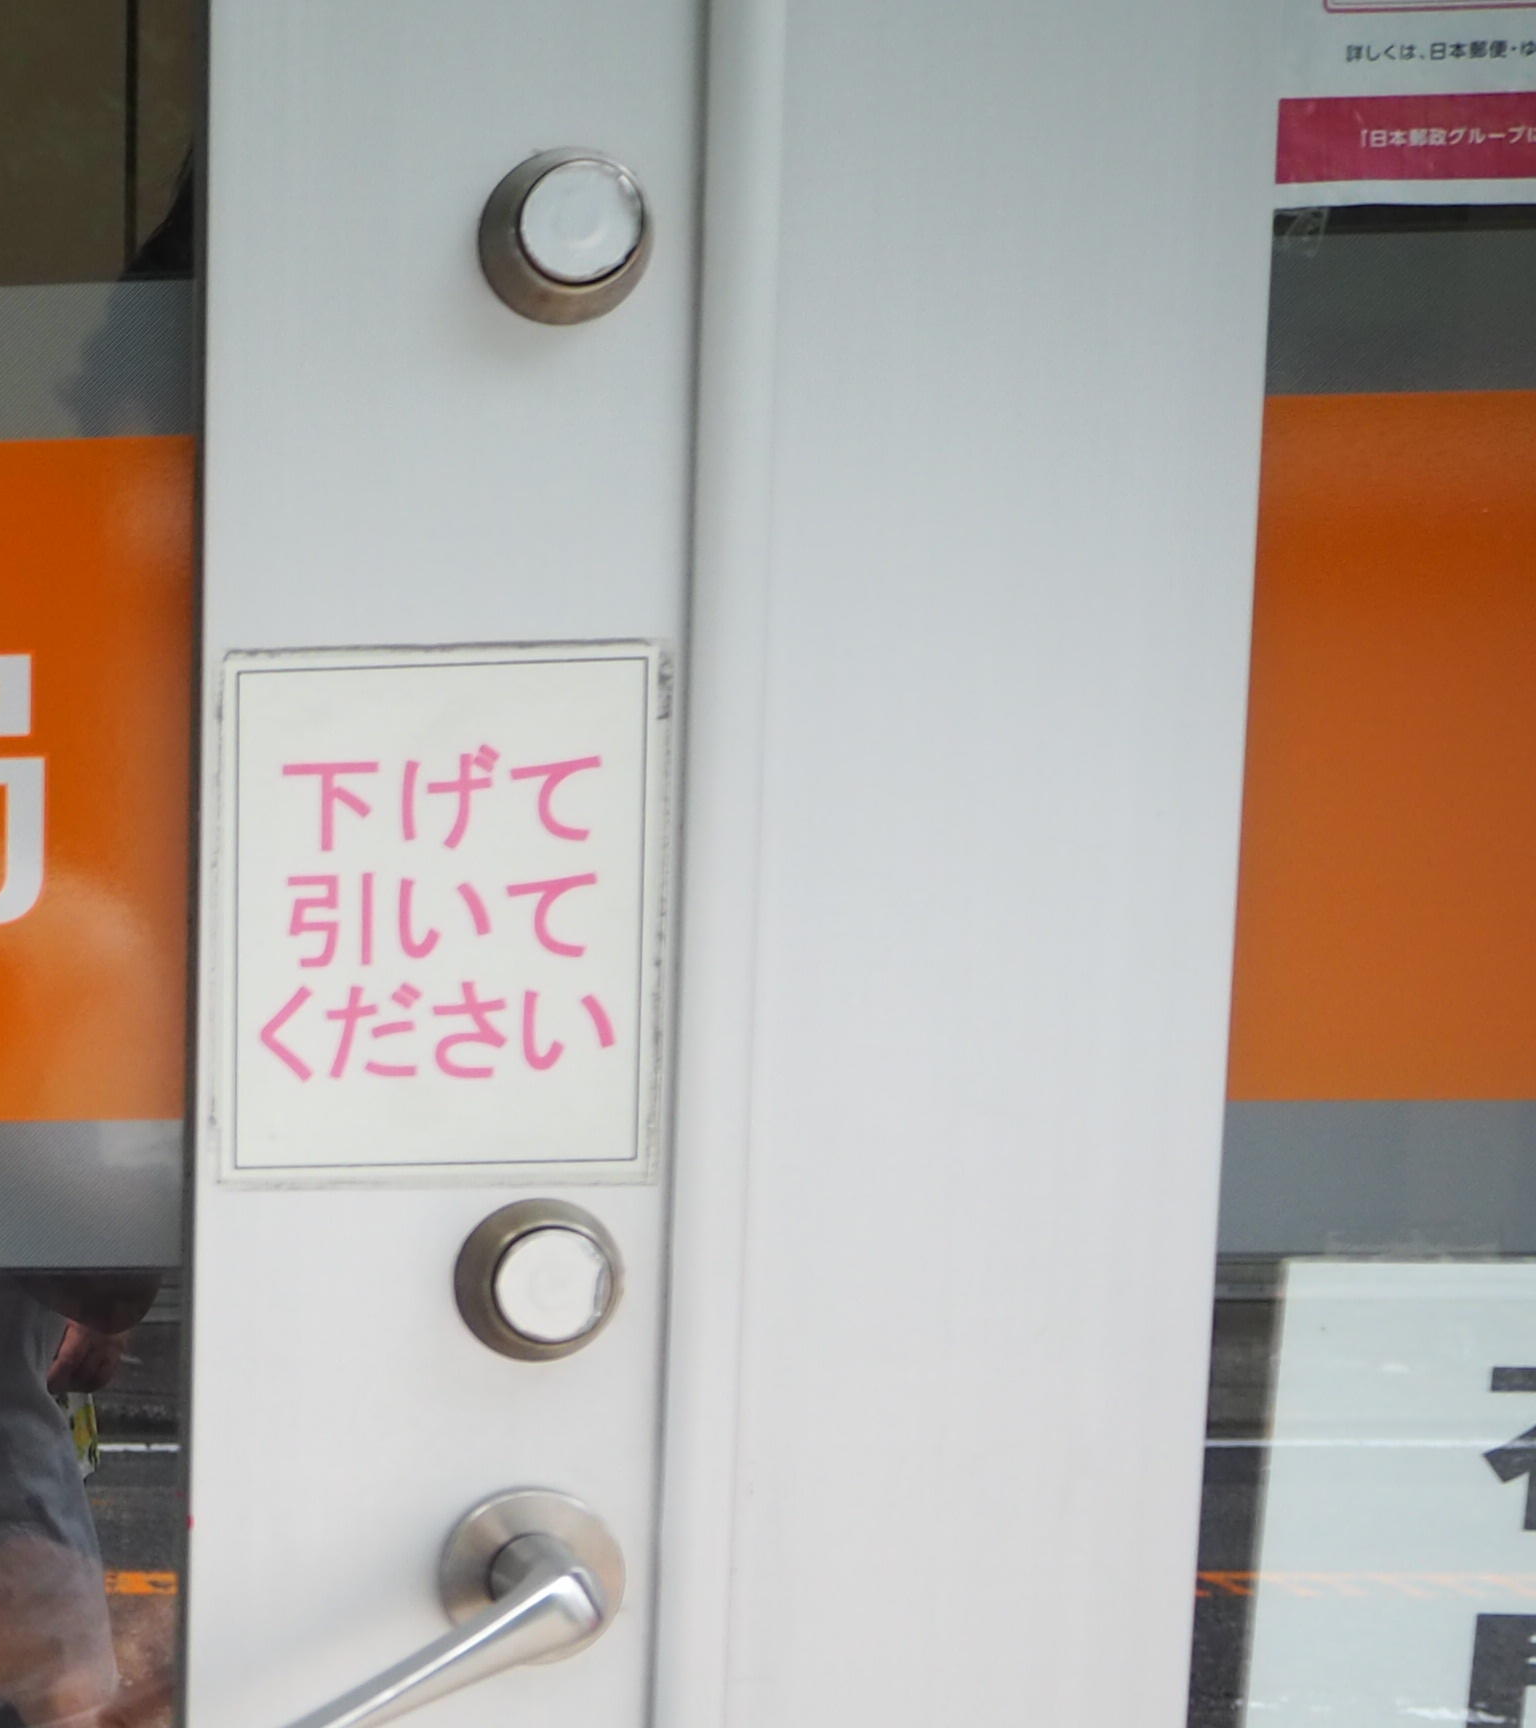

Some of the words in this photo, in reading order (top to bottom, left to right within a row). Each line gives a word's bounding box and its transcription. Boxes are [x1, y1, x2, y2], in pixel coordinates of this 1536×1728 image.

[282, 744, 602, 852] 下げて
[286, 871, 598, 969] 引いて
[259, 981, 616, 1082] ください
